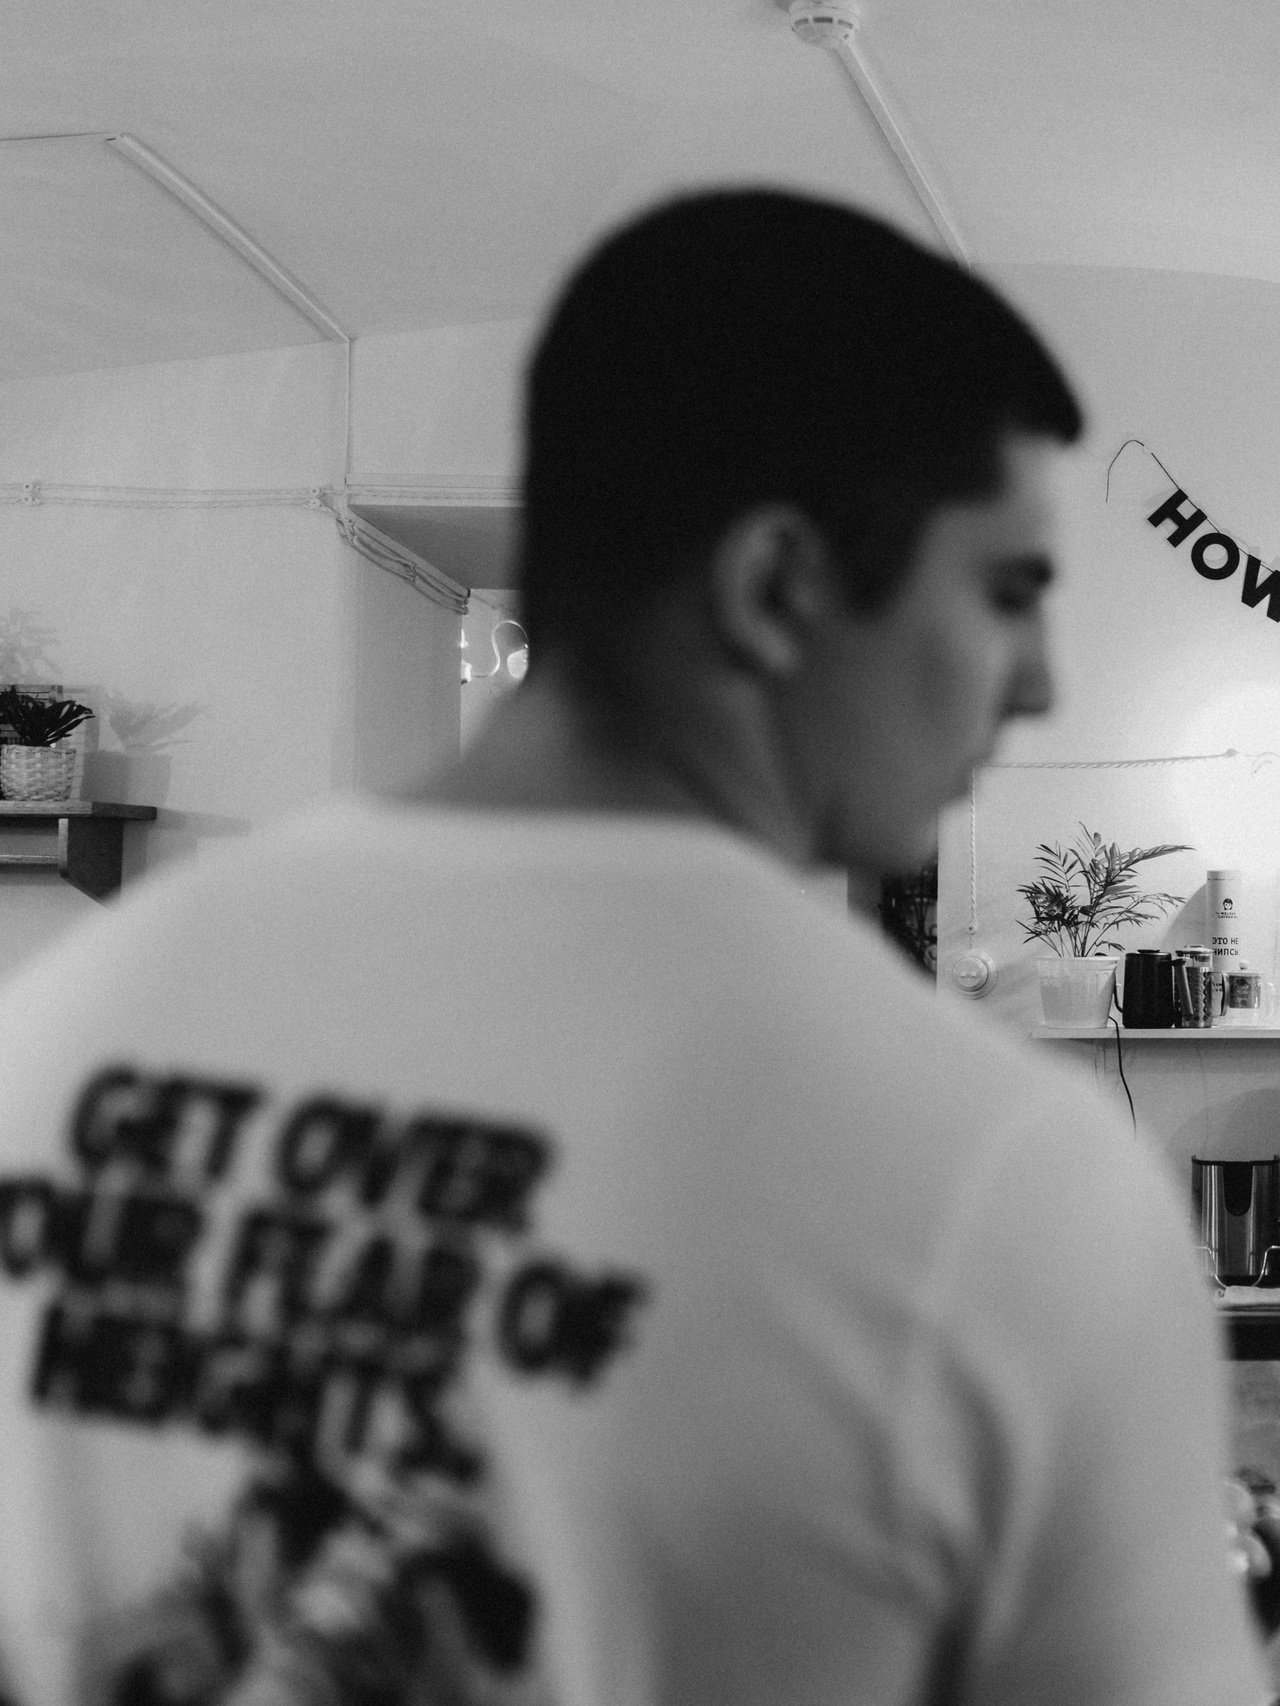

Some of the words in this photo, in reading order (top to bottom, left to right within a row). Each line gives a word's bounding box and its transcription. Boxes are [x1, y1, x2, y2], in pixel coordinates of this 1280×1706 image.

[1212, 936, 1228, 945] ЭТО
[1230, 937, 1239, 945] НЕ
[72, 1064, 266, 1186] GET
[276, 1090, 556, 1238] OVER
